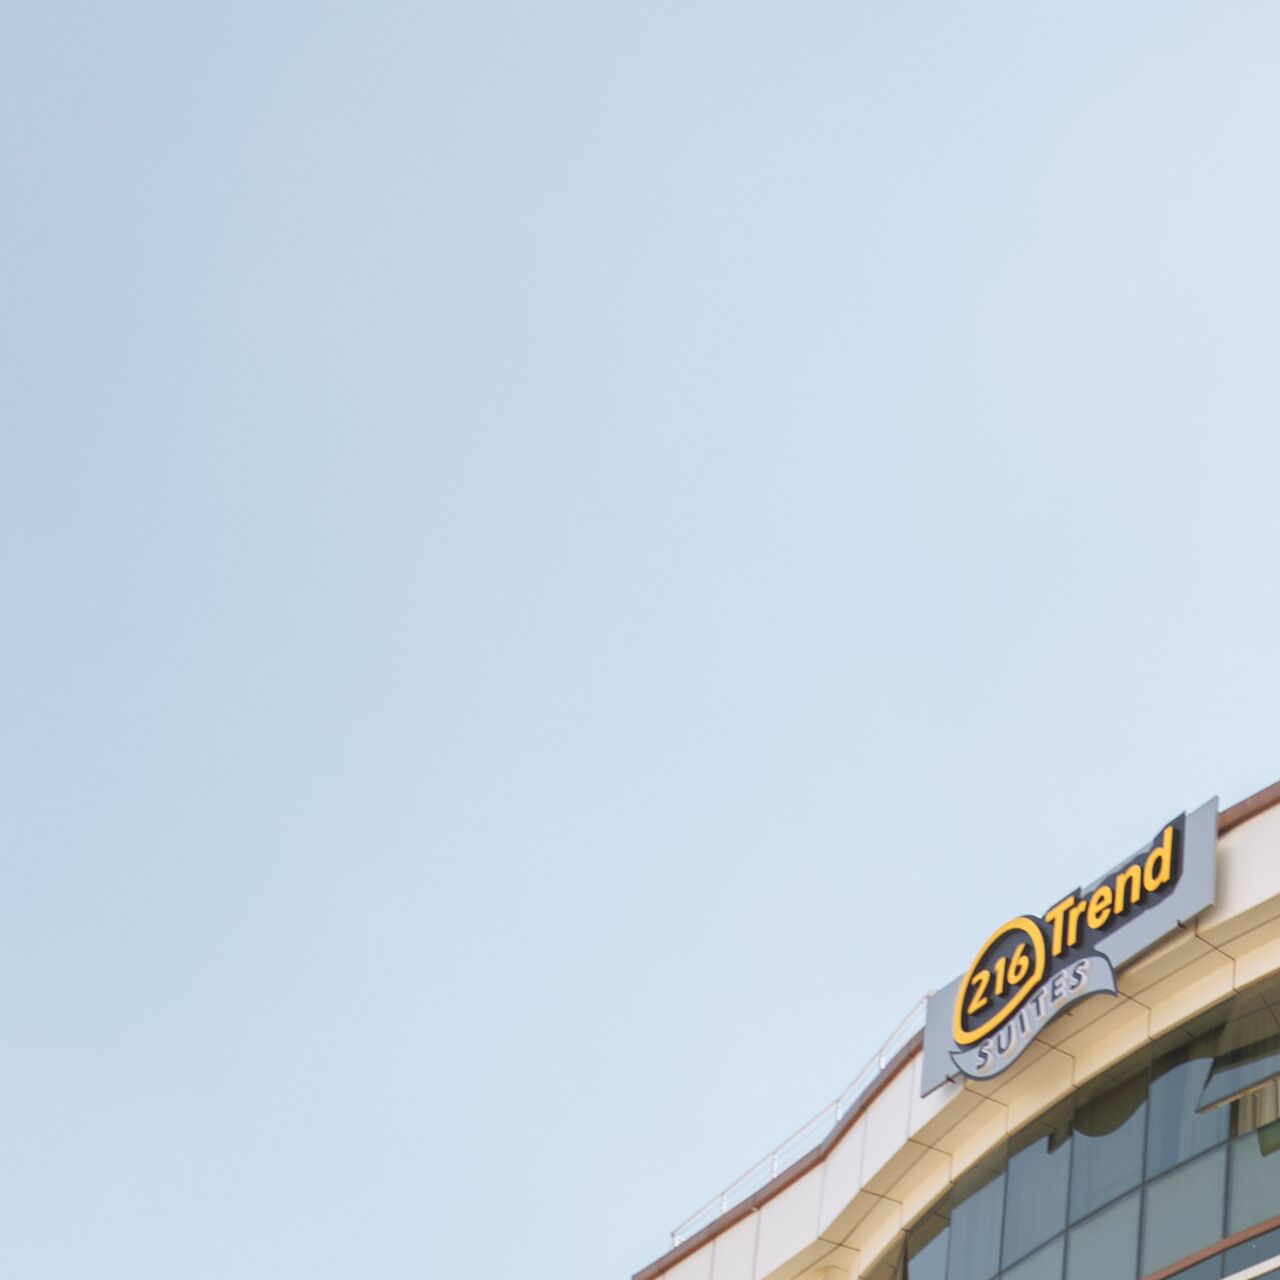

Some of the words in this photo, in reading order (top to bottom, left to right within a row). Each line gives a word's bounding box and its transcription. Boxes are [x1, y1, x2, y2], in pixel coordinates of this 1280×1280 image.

[967, 943, 1030, 1016] 216
[1046, 825, 1174, 957] Trend
[976, 959, 1092, 1071] SUITES
